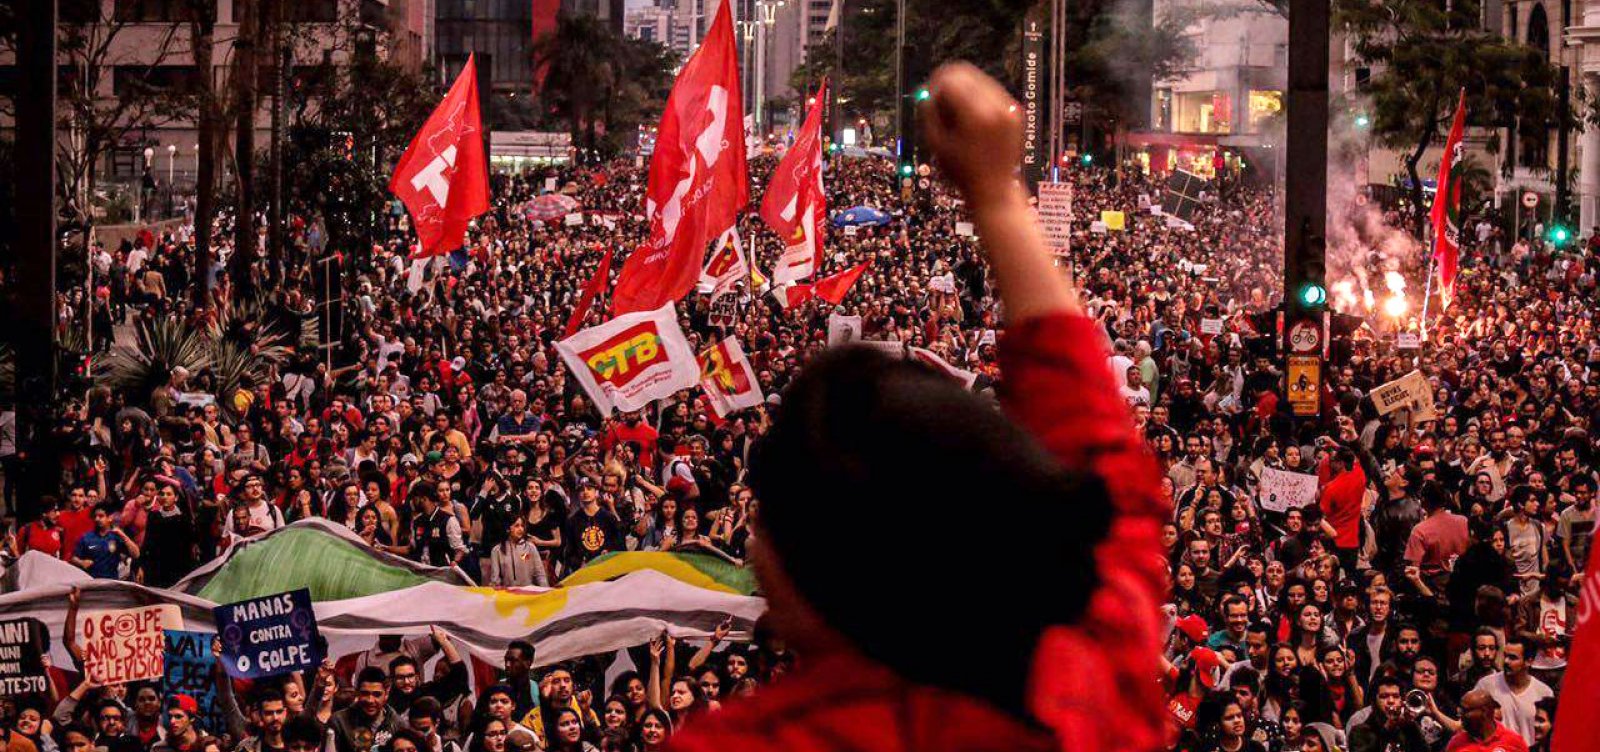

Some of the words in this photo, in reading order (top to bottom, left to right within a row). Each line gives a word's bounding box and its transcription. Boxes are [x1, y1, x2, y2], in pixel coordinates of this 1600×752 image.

[1025, 52, 1037, 99] Gomide
[1025, 101, 1036, 149] Peixoto
[1024, 151, 1035, 164] R.
[586, 331, 659, 380] CTB
[233, 594, 294, 623] MANAS
[84, 617, 94, 639] O
[100, 608, 163, 638] GOLPE
[249, 624, 292, 644] CONTRA
[86, 636, 117, 661] NÃO
[236, 655, 250, 672] O
[258, 643, 311, 672] GOLPE
